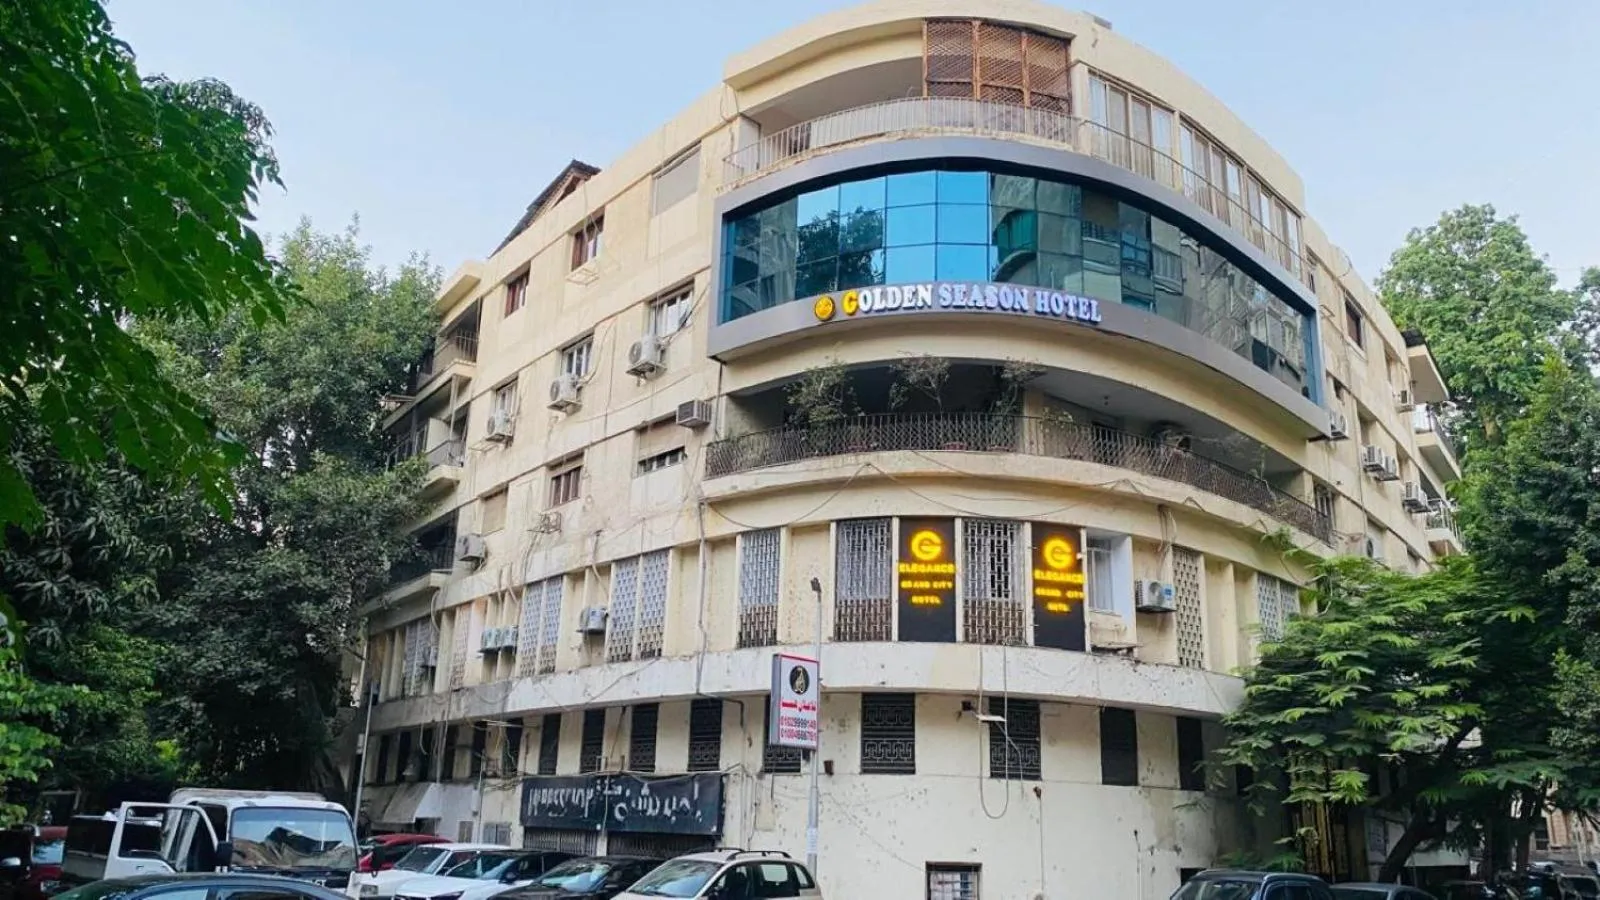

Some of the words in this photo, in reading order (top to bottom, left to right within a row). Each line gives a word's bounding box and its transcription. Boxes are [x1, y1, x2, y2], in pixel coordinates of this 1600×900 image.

[842, 284, 933, 315] GOLDEN
[938, 284, 1029, 311] SEASON
[1035, 290, 1101, 322] HOTEL
[899, 563, 955, 574] ELEGANCE
[932, 580, 953, 589] CITY
[911, 595, 941, 604] HOTEL
